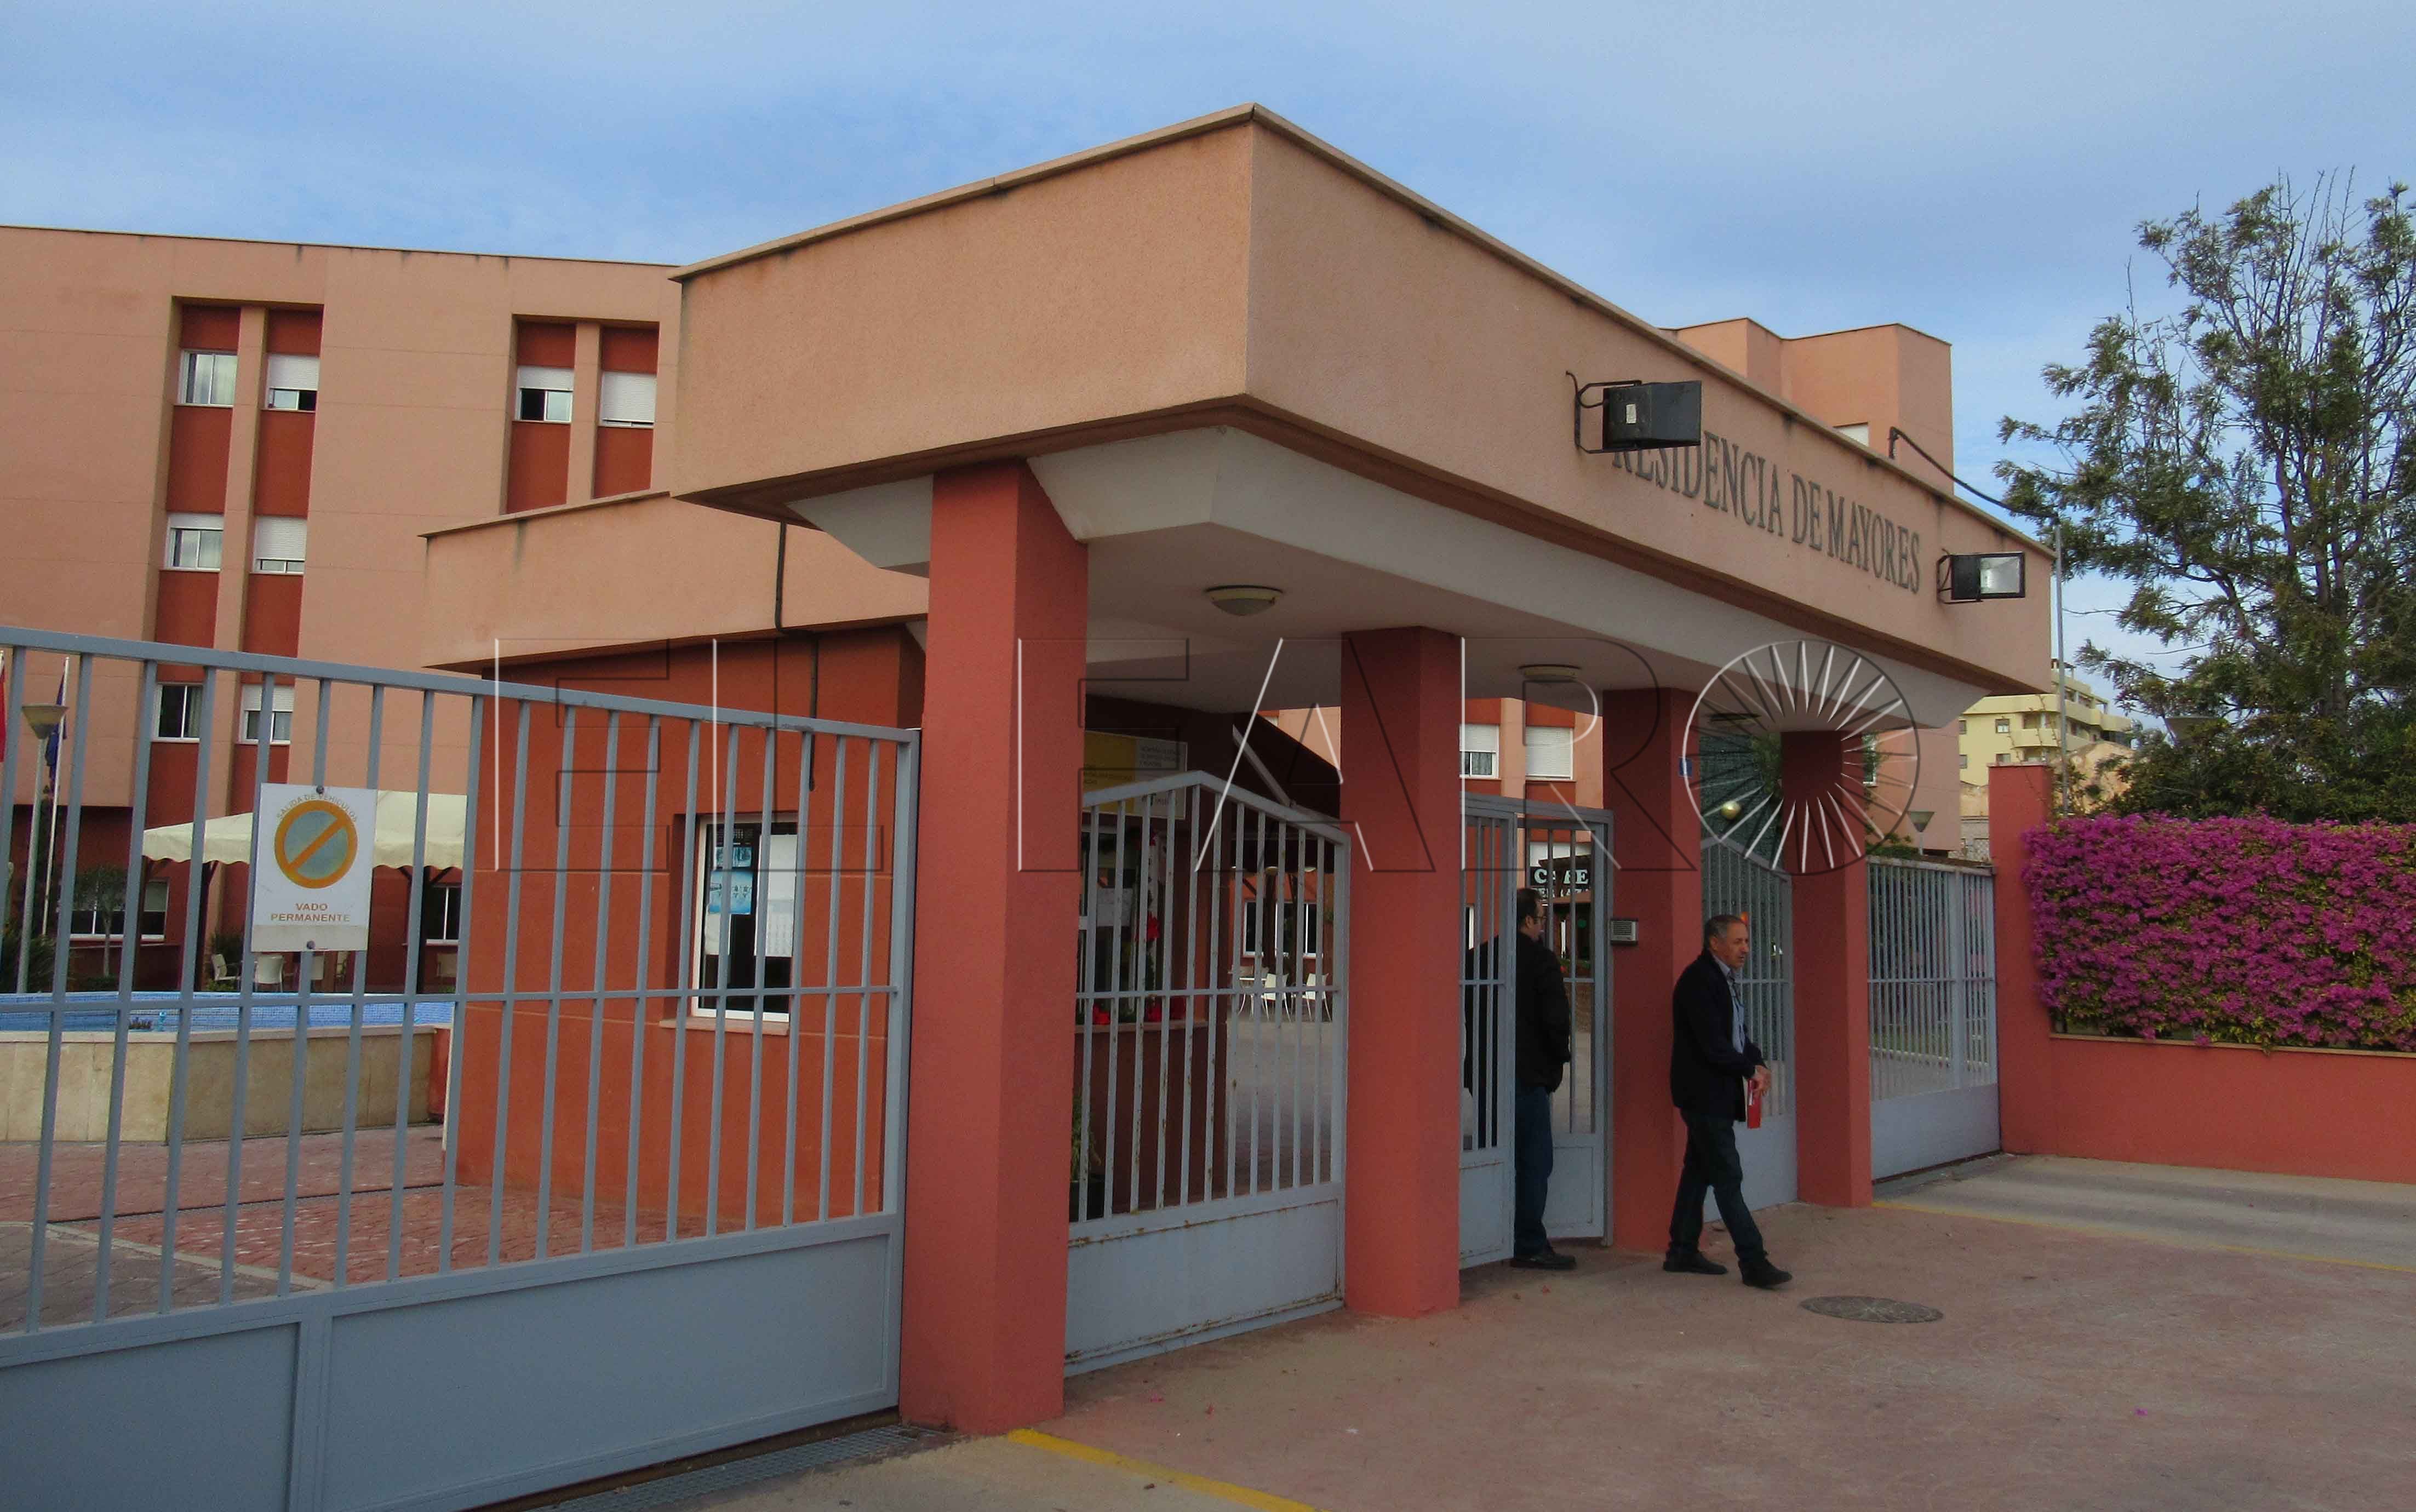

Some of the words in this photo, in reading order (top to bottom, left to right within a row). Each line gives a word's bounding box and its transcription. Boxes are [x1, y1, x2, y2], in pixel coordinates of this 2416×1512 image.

[1612, 430, 1784, 537] SIDENCIA
[1791, 473, 1823, 552] DE
[1826, 489, 1920, 594] MAYORES
[295, 903, 328, 912] VADO
[271, 913, 351, 922] PERMANENTE
